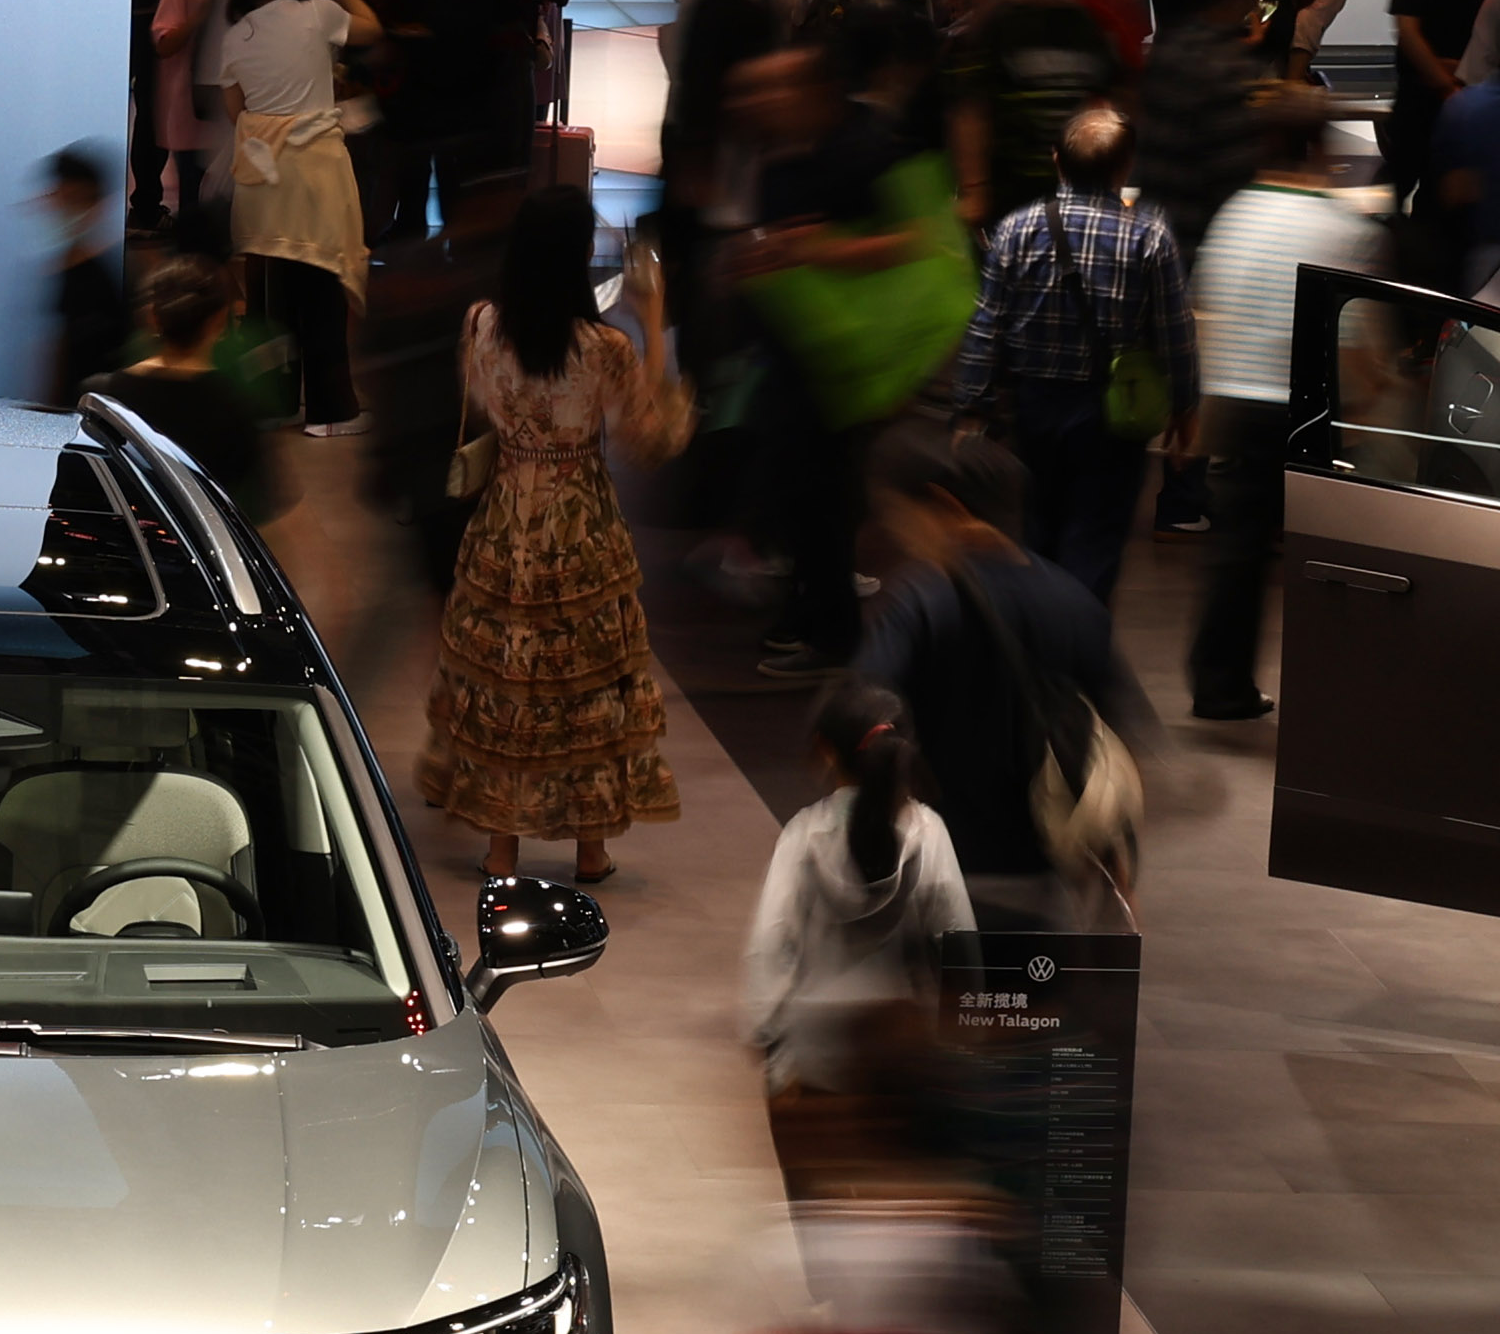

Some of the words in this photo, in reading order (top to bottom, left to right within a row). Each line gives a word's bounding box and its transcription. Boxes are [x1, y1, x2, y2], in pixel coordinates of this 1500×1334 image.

[959, 992, 1028, 1009] 全新揽境
[958, 1013, 994, 1026] New
[997, 1013, 1060, 1031] Talagon
